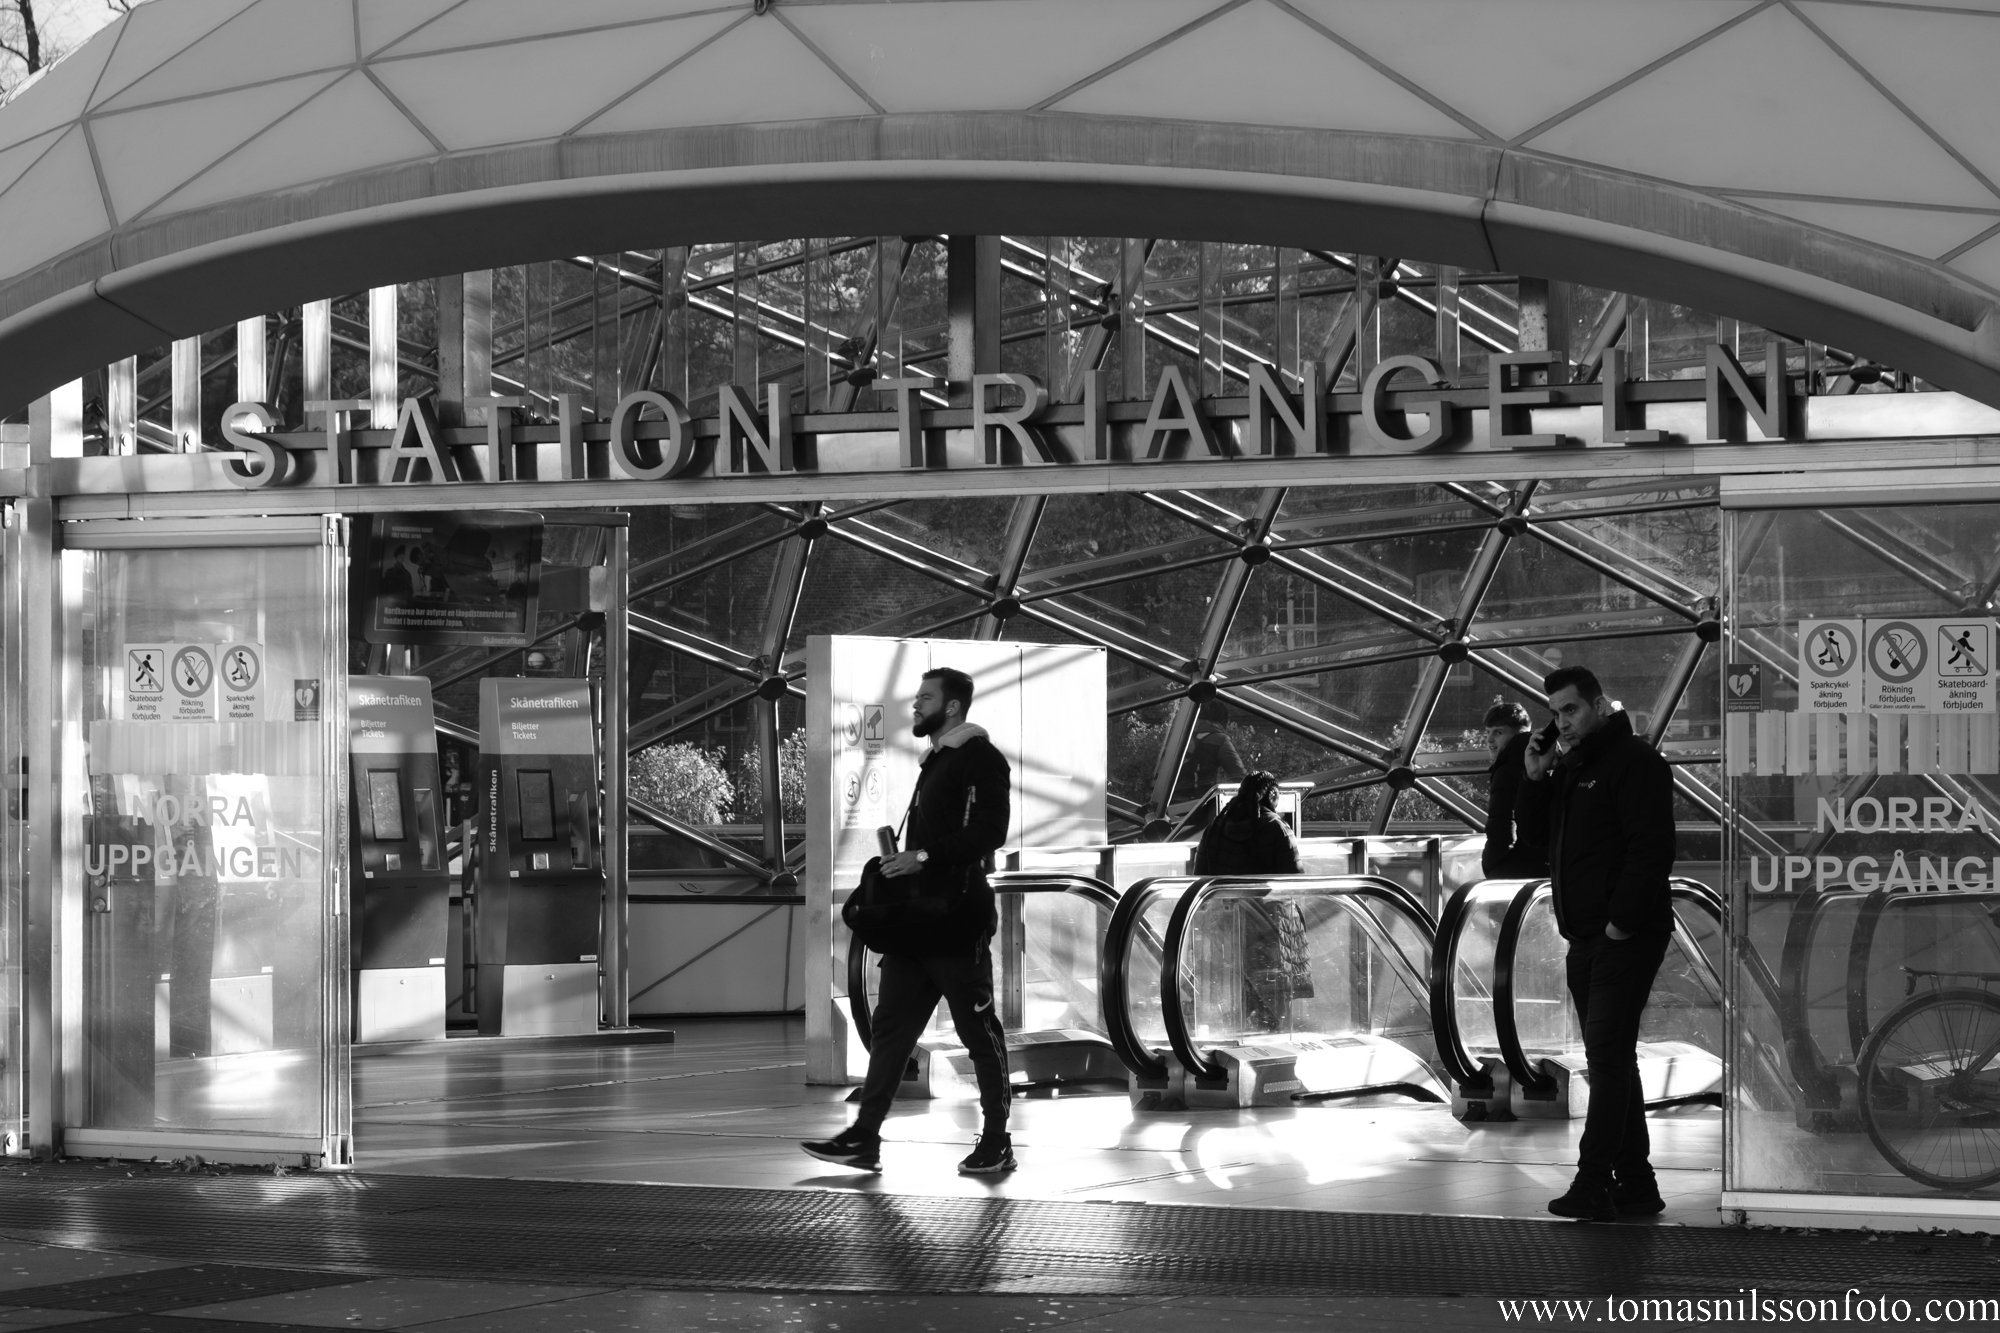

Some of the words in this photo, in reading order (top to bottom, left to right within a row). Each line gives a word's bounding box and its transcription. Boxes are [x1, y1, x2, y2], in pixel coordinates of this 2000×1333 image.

[221, 383, 793, 489] STATION
[873, 341, 1794, 468] TRIANGELN
[1810, 680, 1851, 691] Sparkcykel-
[1881, 684, 1913, 695] Rökning
[1938, 679, 1988, 689] Skateboard-
[128, 694, 164, 703] Skateboard-
[358, 694, 422, 707] Skånetrafiken
[1818, 690, 1843, 700] åkning
[1879, 693, 1916, 704] förbjuden
[1949, 689, 1977, 701] åkning
[136, 703, 157, 712] åkning
[181, 699, 204, 707] Rökning
[510, 697, 579, 709] Skånetrafiken
[1813, 699, 1848, 709] förbjuden
[1942, 699, 1984, 711] förbjuden
[132, 712, 161, 721] förbjuden
[179, 707, 206, 715] förbjuden
[360, 719, 387, 729] Biljetter
[511, 722, 539, 731] Biljetter
[361, 729, 385, 738] Tickets
[512, 731, 537, 740] Tickets
[132, 794, 255, 827] NORRA
[489, 769, 498, 853] Skånetrafiken
[1816, 796, 1990, 834] NORRA
[84, 839, 301, 878] UPPGÅNGEN
[1750, 849, 2000, 893] UPPGÅNG
